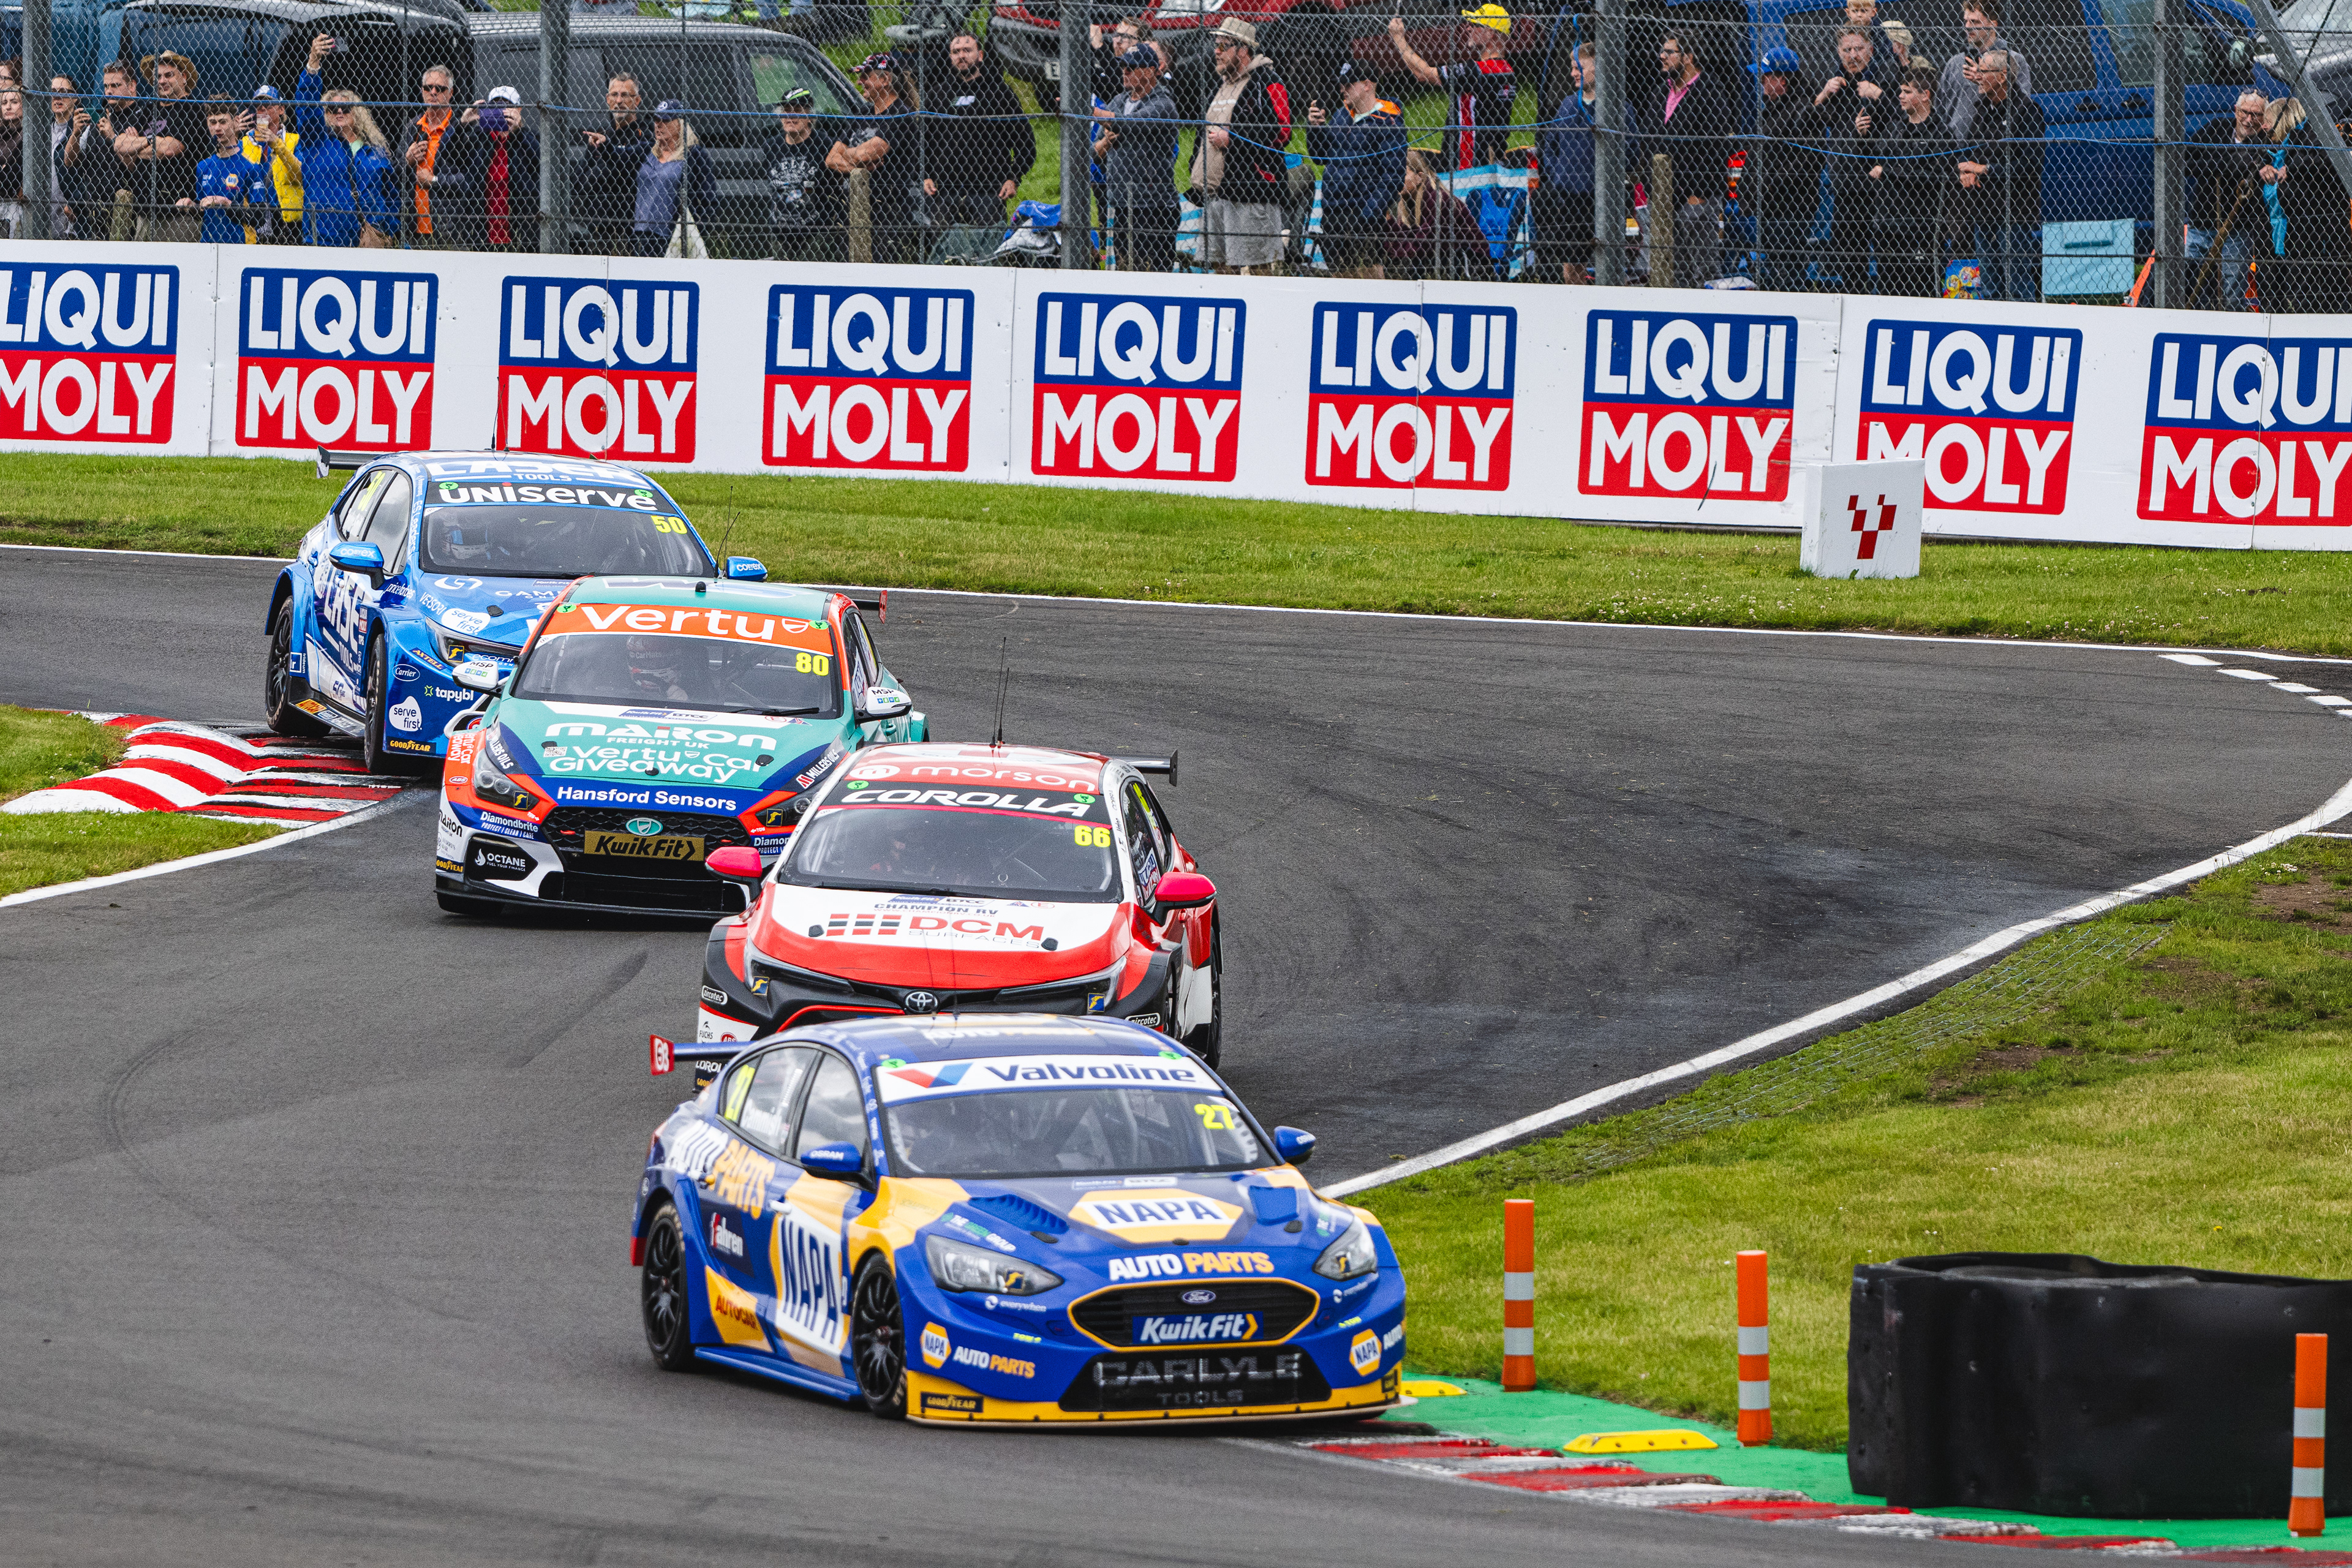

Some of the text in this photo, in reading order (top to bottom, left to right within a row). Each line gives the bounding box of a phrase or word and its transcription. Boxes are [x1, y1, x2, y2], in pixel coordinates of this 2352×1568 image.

[249, 276, 429, 358] LIQUI
[509, 285, 689, 368] LIQUI
[777, 292, 964, 376] LIQUI
[1044, 301, 1235, 385] LIQUI
[1320, 311, 1506, 393] LIQUI
[1594, 318, 1786, 404] LIQUI
[1871, 328, 2071, 414] LIQUI
[245, 366, 431, 444] MOLY
[507, 374, 693, 453] MOLY
[772, 383, 967, 462] MOLY
[1041, 393, 1238, 472] MOLY
[1316, 402, 1510, 482] MOLY
[1589, 411, 1790, 492] MOLY
[514, 473, 571, 482] TOOLS
[651, 515, 688, 534] 50
[419, 592, 448, 616] VERSORI
[451, 608, 483, 625] serve
[581, 605, 776, 641] Vertu
[412, 649, 443, 669] AXTELL
[796, 652, 829, 676] 80
[395, 667, 417, 677] Carrier
[393, 706, 417, 717] serve
[390, 739, 431, 752] GOODYEAR
[607, 737, 680, 747] FREIGHT
[497, 752, 514, 769] OILS
[550, 756, 738, 784] Giveaway
[808, 748, 840, 778] MILLERS OILS
[911, 765, 1095, 792] morson
[557, 786, 737, 811] Hansford Sensors
[842, 789, 1091, 818] COROLLA
[480, 811, 538, 832] Diamondbrite
[481, 822, 534, 840] PROTECT CLEAN CARE
[594, 835, 686, 859] KwikFit
[1074, 826, 1111, 848] 66
[487, 852, 526, 867] OCTANE
[874, 903, 969, 913] CHAMPION
[908, 930, 1040, 949] SURFACES
[909, 916, 1044, 941] DCM
[703, 989, 723, 1002] zircotec
[699, 1030, 714, 1040] FUCHS
[984, 1061, 1195, 1083] Valvoline
[1194, 1104, 1235, 1129] 27
[809, 1150, 845, 1161] OSRAM
[1093, 1199, 1223, 1224] NAPA
[1108, 1251, 1275, 1281] AUTO PARTS
[782, 1217, 839, 1346] NAPA
[1188, 1290, 1211, 1303] Ford
[1140, 1314, 1245, 1344] KwikFit
[923, 1332, 948, 1359] NAPA
[1354, 1338, 1379, 1365] NAPA
[952, 1346, 1036, 1379] AUTO PARTS
[1092, 1352, 1303, 1387] CARLYLE
[925, 1395, 976, 1409] GOODYEAR
[1156, 1390, 1243, 1406] TOOLS
